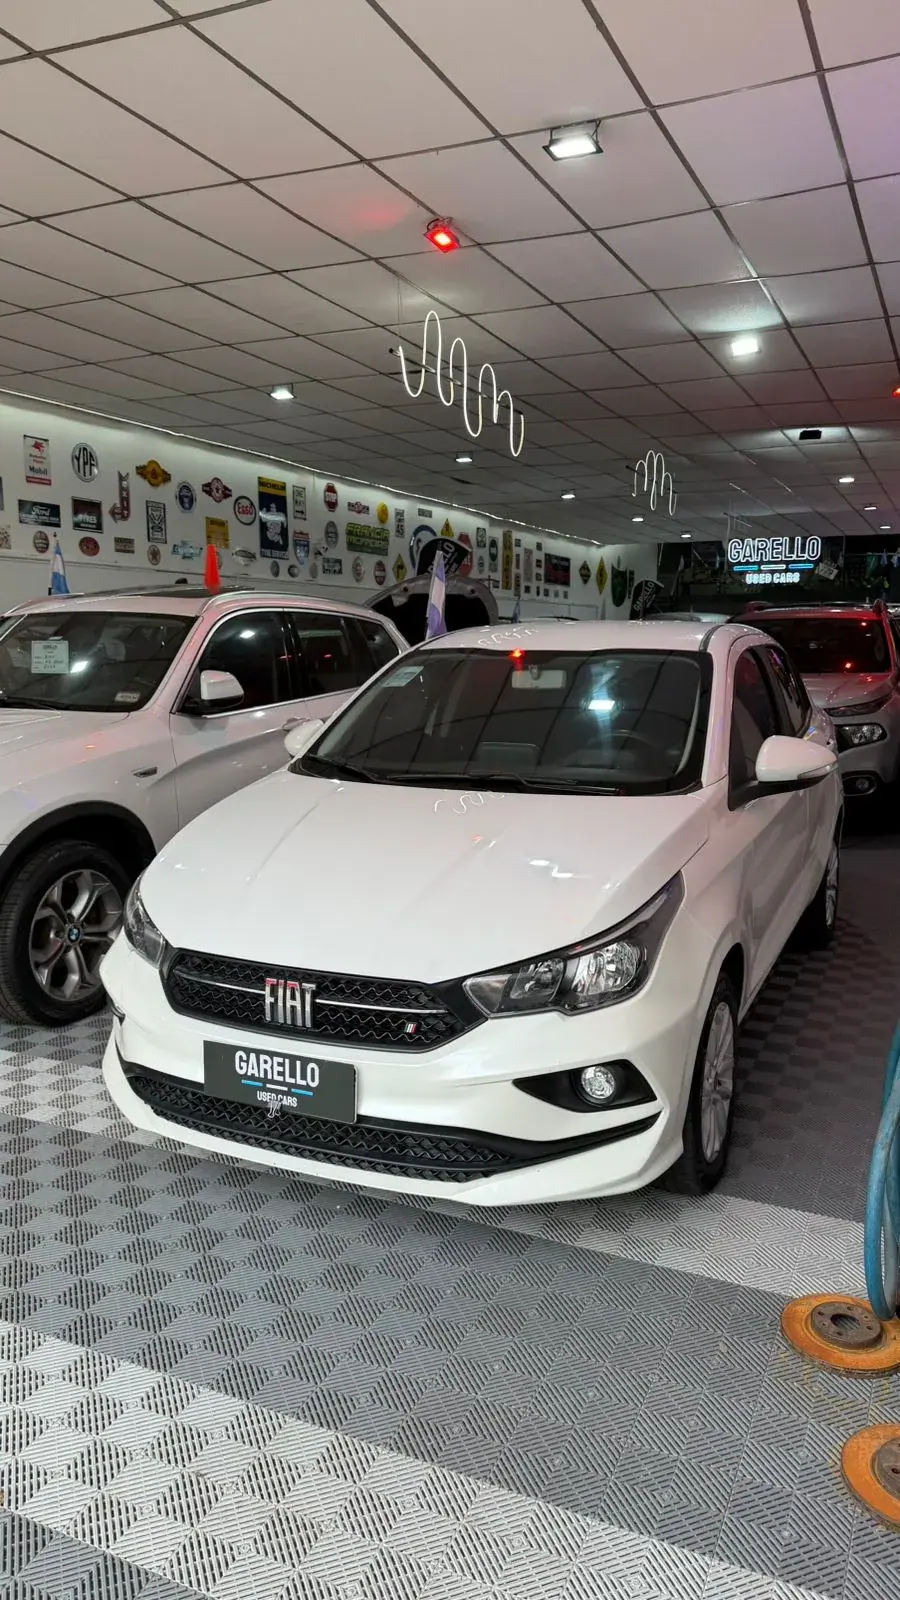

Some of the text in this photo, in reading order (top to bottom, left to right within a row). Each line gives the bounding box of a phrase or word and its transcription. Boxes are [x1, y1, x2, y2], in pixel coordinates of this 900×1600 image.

[29, 465, 48, 476] Mobil
[74, 446, 97, 477] YPF
[31, 505, 51, 516] Ford
[728, 536, 821, 562] GARELLO
[745, 572, 800, 585] USED CARS
[265, 977, 316, 1028] FIAT
[234, 1050, 320, 1088] GARELLO
[257, 1090, 298, 1108] USED CARS
